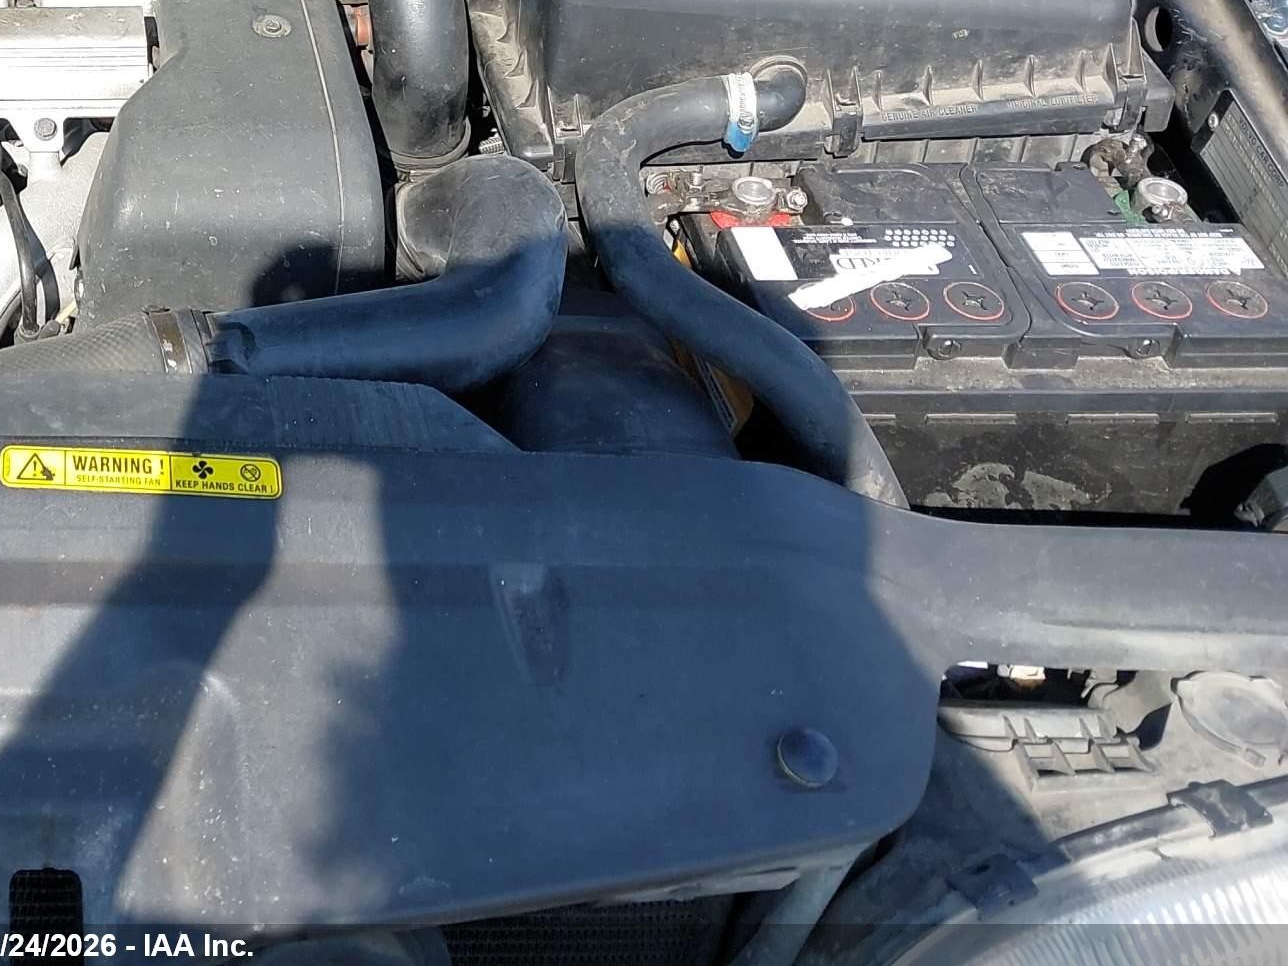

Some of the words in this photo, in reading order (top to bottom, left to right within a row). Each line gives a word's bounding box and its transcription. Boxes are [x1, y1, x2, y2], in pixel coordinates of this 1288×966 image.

[881, 109, 919, 122] GENUINE
[920, 107, 935, 120] AIR
[938, 105, 978, 117] CLEANER
[1238, 118, 1257, 146] VOLVO
[1255, 144, 1269, 166] CAR
[73, 455, 153, 474] WARNING
[159, 459, 165, 475] !
[76, 474, 142, 485] SELF-STARTING
[144, 477, 161, 486] FAN
[175, 479, 199, 489] KEEP
[201, 481, 234, 491] HANDS
[237, 483, 268, 493] CLEAR
